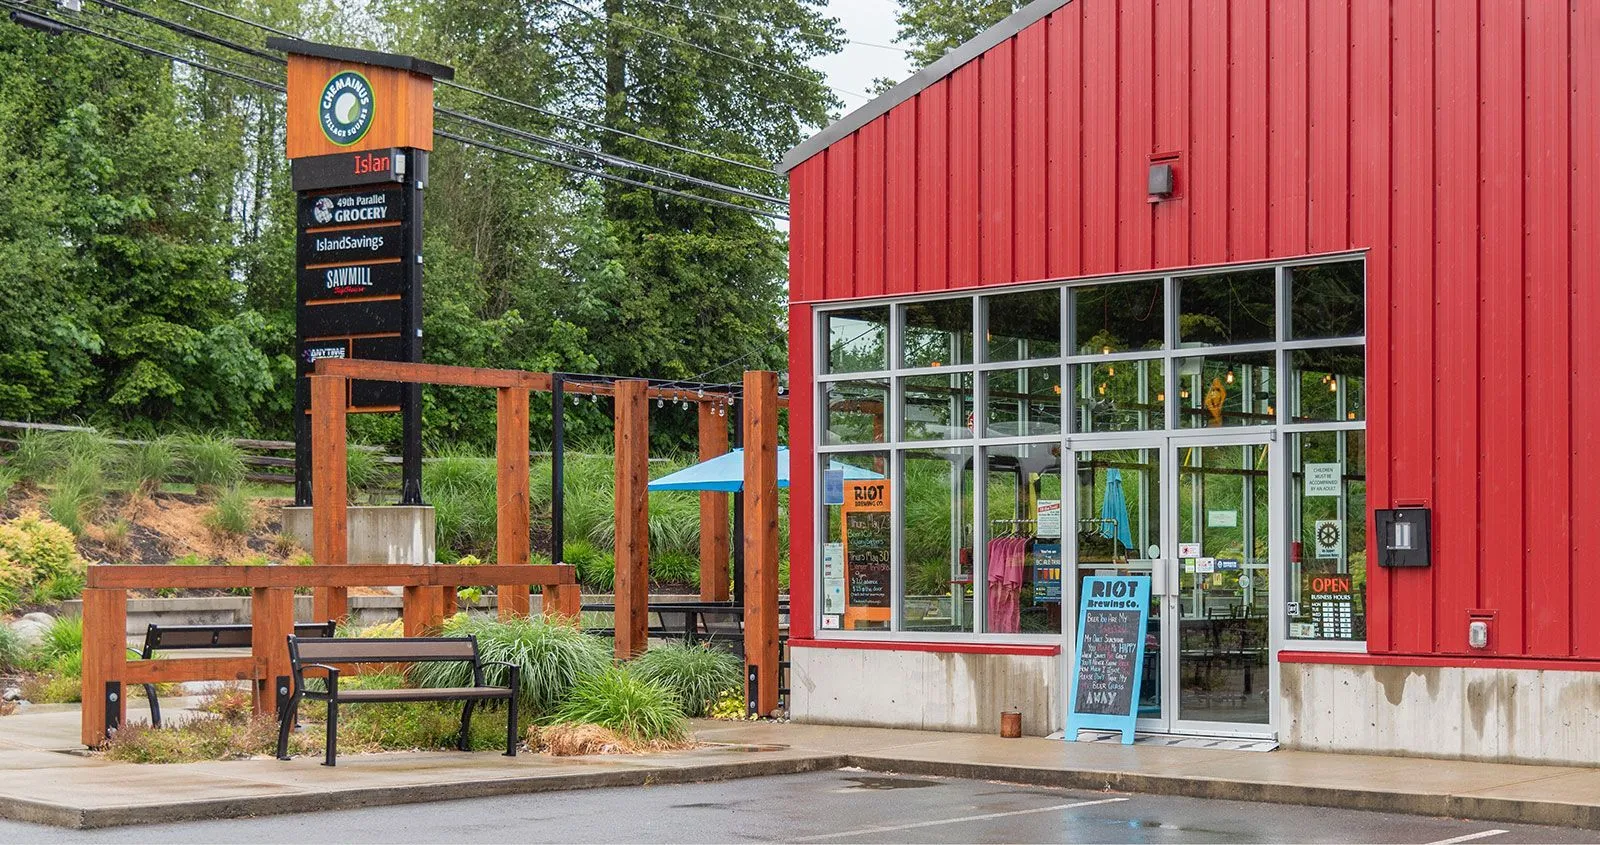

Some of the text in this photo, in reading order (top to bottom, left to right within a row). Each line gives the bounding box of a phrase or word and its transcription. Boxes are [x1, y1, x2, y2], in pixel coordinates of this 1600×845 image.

[323, 77, 370, 109] CHEMAINUS
[324, 108, 368, 137] VILLAGE SQUARE
[354, 153, 391, 174] Islan
[337, 194, 386, 207] 49th Parallel
[334, 206, 387, 222] GROCERY
[316, 235, 384, 251] IslandSavings
[326, 267, 373, 289] SAWMILL
[311, 347, 345, 357] ANYTIME
[854, 485, 884, 500] RIOT
[879, 550, 889, 562] 30
[1091, 580, 1138, 598] RIOT
[1312, 577, 1349, 592] OPEN
[1087, 599, 1139, 609] Brewing Co.
[1119, 642, 1136, 653] HAPPY
[1086, 691, 1117, 705] AWAY
